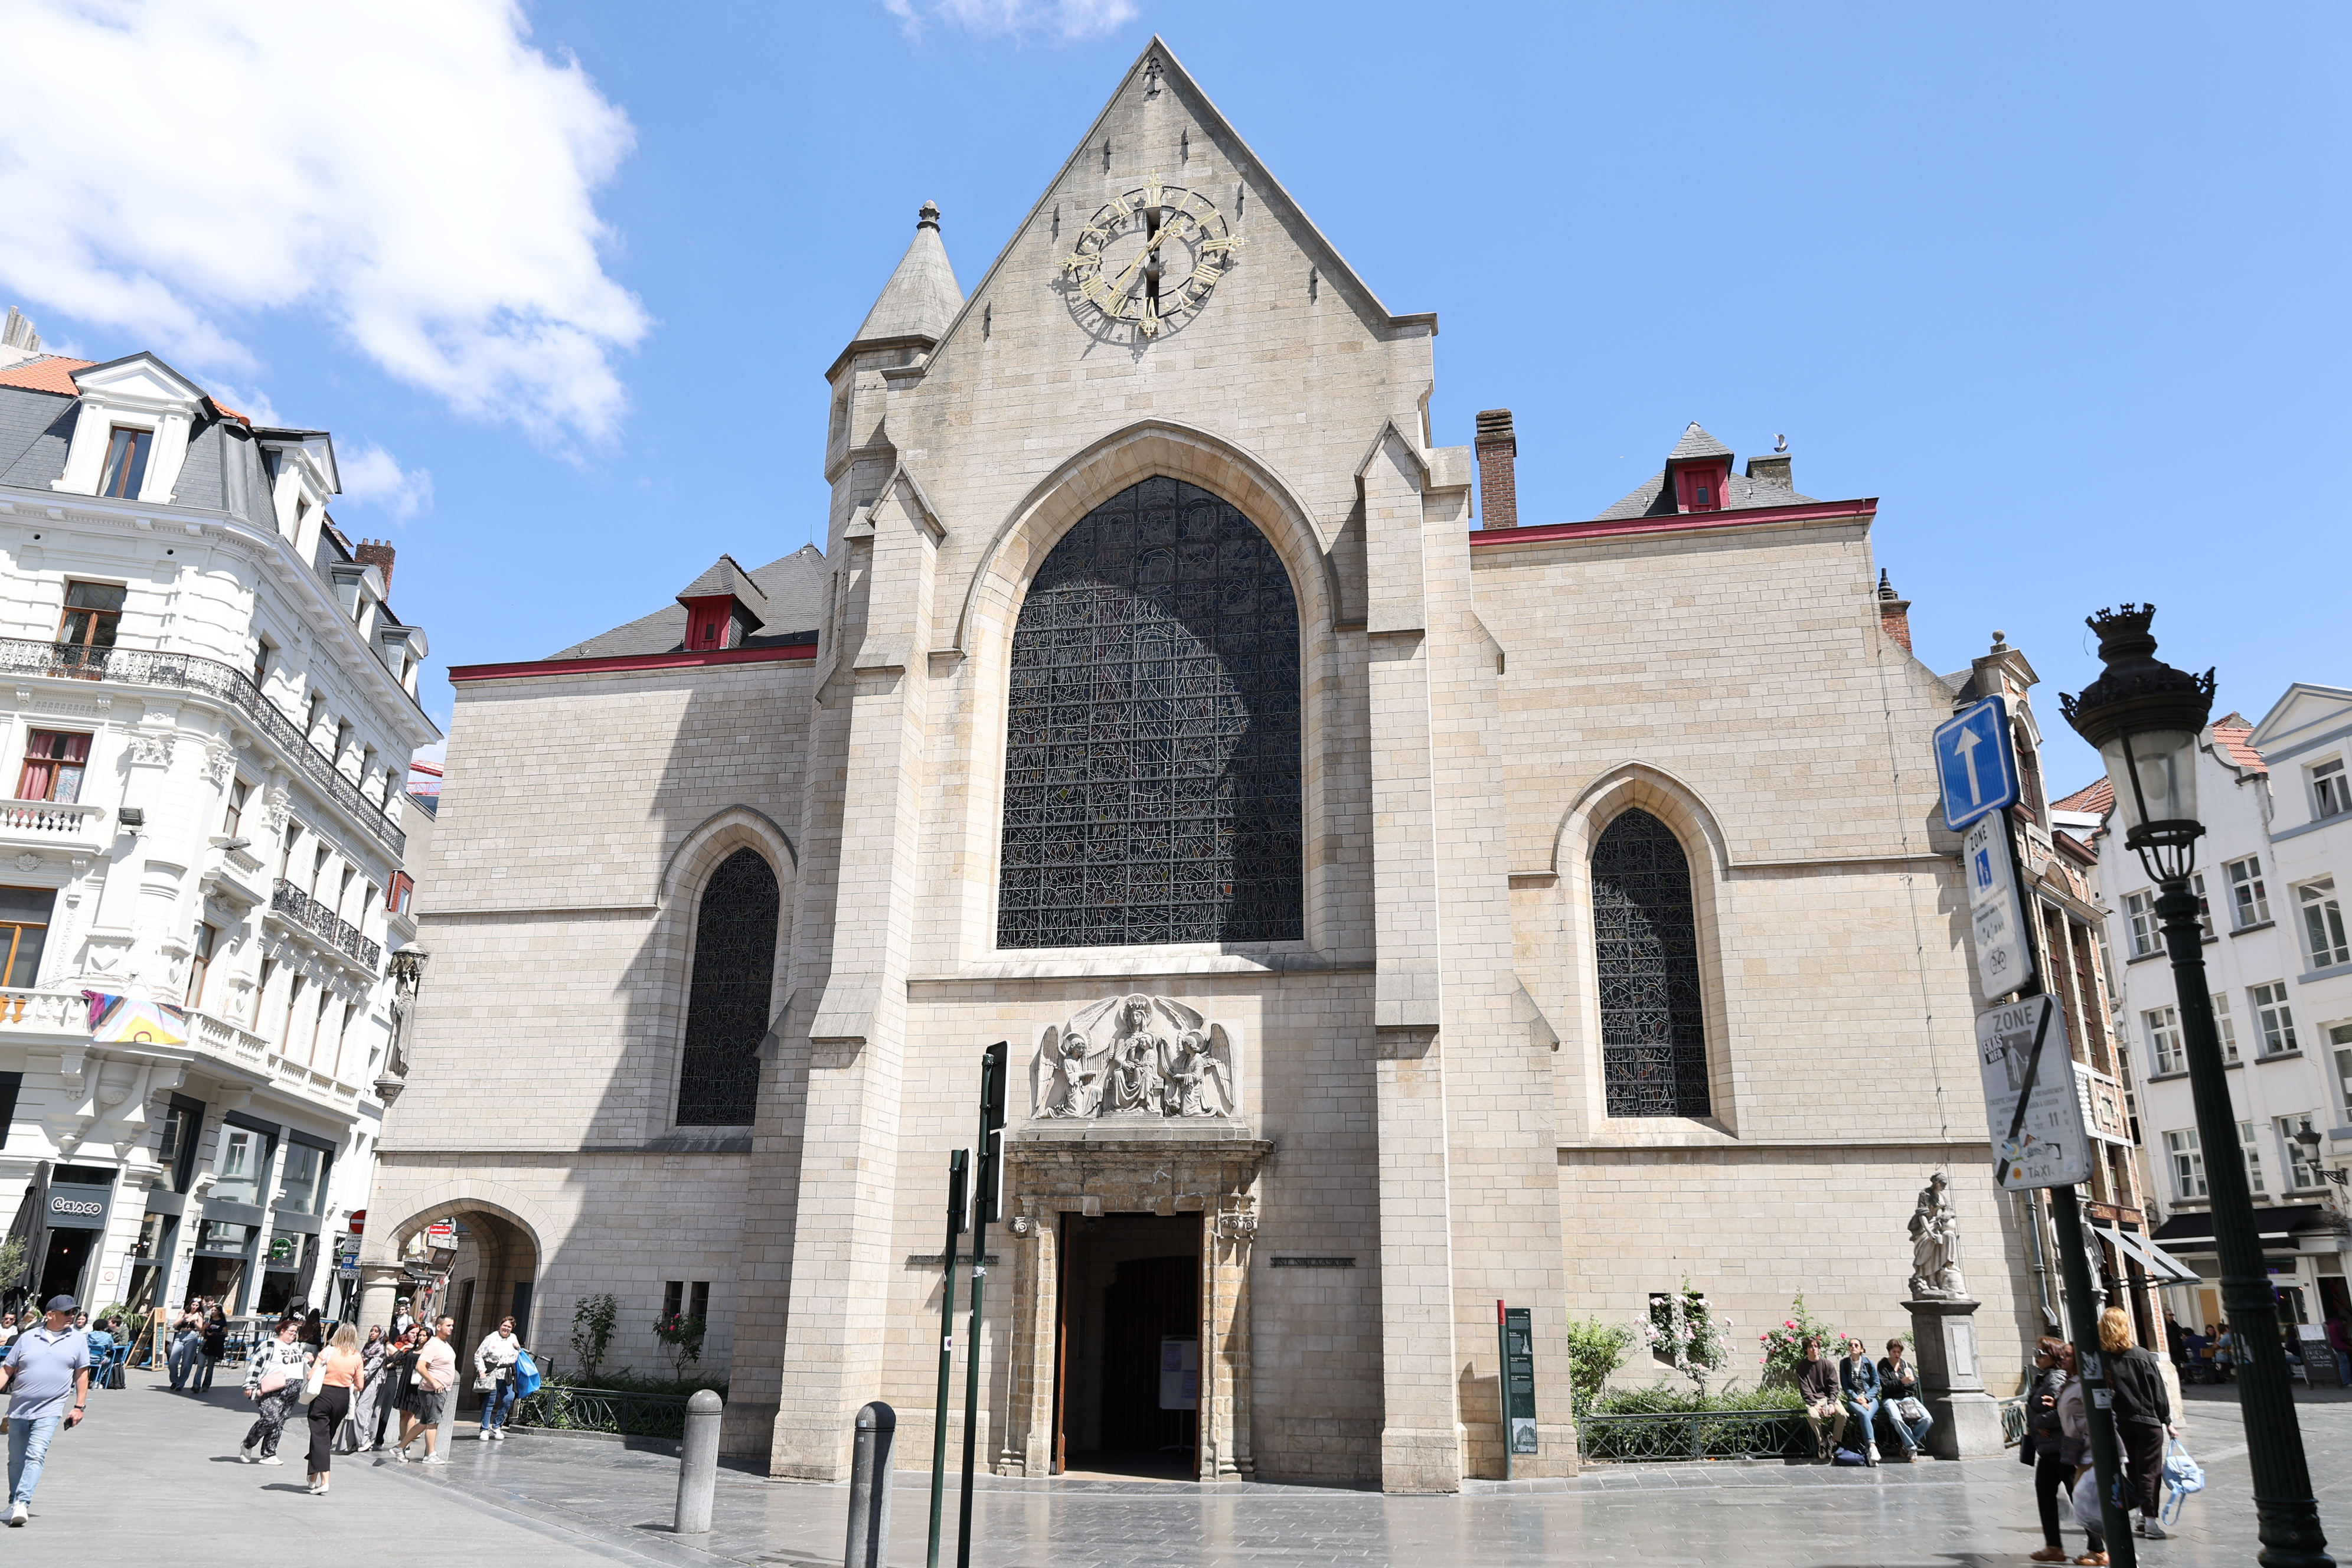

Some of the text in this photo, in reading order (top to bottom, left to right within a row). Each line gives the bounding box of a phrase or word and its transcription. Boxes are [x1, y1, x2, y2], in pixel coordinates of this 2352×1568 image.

[1969, 824, 1987, 852] ZONE
[1992, 1005, 2035, 1033] ZONE
[1982, 1035, 2003, 1055] EKAS
[2049, 1111, 2059, 1127] 11
[2027, 1164, 2051, 1178] TAXI
[51, 1197, 102, 1216] Casco
